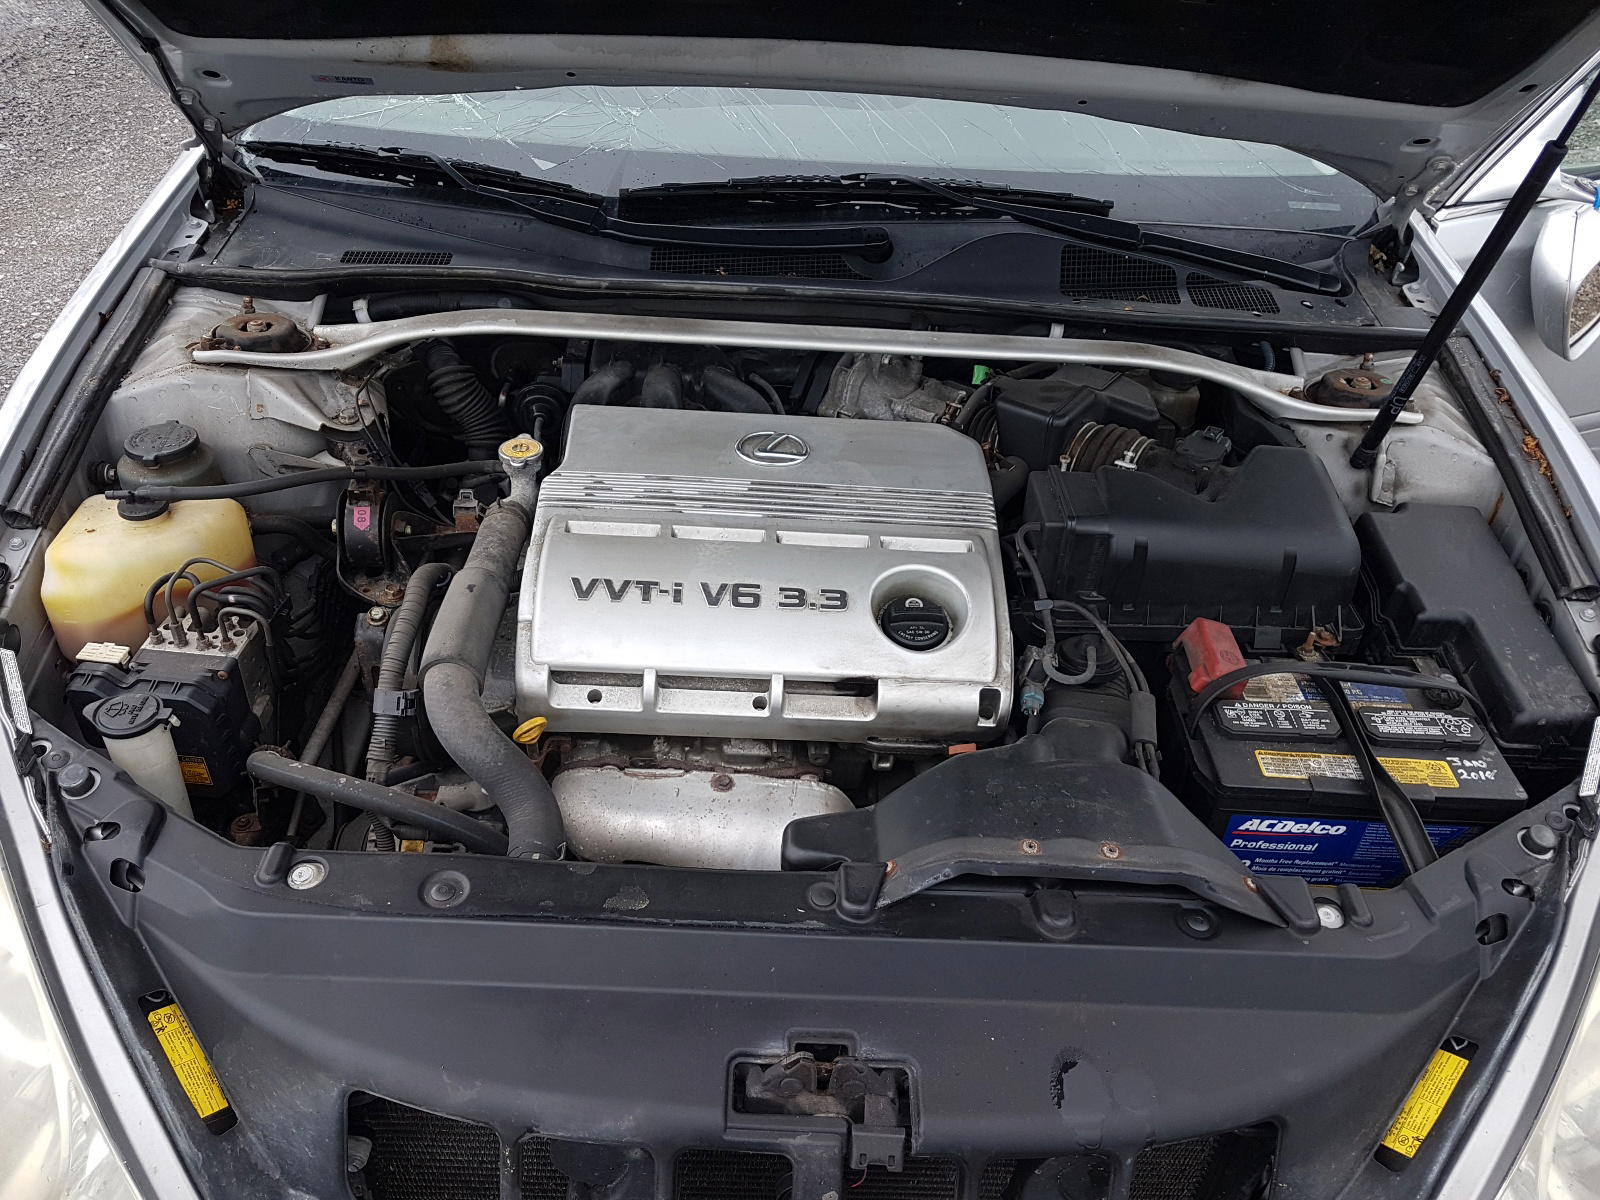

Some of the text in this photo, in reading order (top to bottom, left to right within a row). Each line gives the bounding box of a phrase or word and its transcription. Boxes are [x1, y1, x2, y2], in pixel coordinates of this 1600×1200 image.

[571, 577, 849, 612] VVT-i V6 3.3
[1237, 818, 1348, 835] ACDelco
[1230, 838, 1319, 852] Professional
